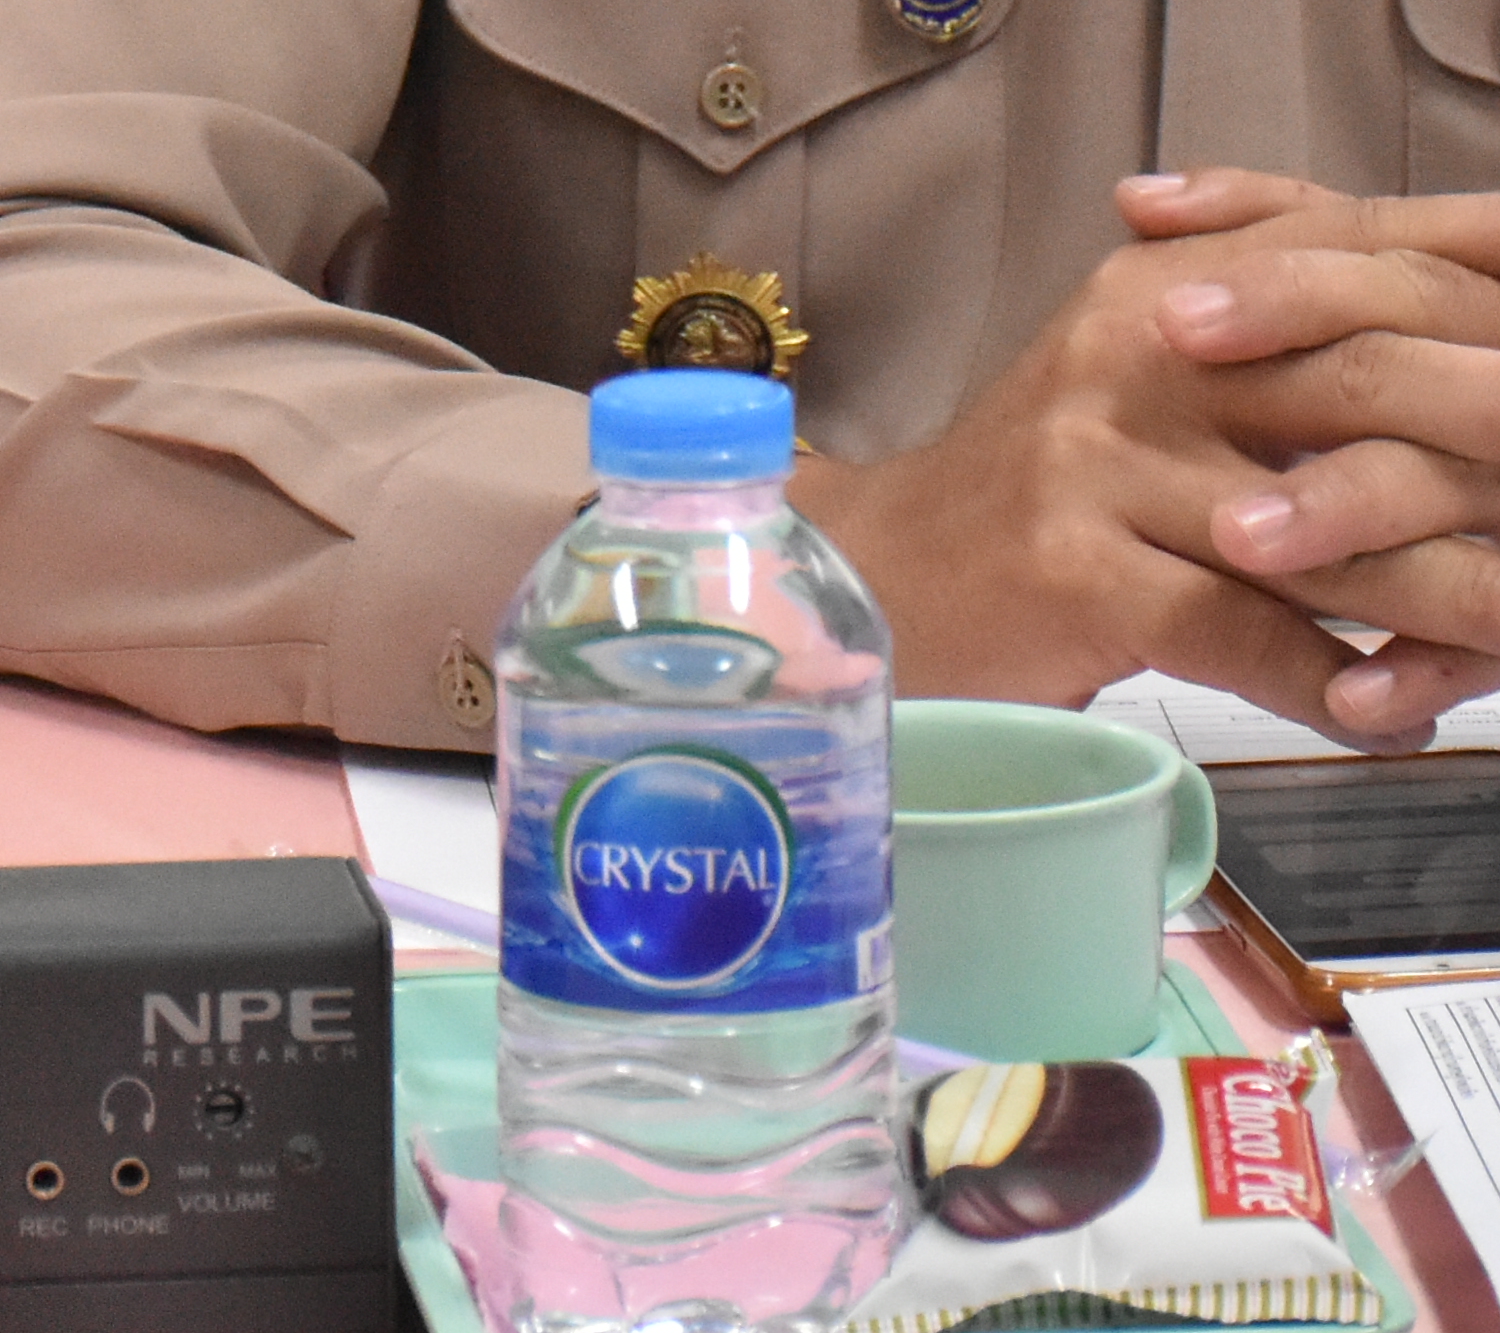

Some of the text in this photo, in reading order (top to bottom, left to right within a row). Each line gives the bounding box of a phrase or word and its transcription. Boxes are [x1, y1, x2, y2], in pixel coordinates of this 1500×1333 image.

[573, 842, 777, 894] CRYSTAL
[142, 987, 356, 1046] NPE
[142, 1046, 359, 1067] RESEARCH
[1223, 1072, 1299, 1159] Choco
[178, 1191, 277, 1214] VOLUME
[1235, 1163, 1308, 1211] Pie
[18, 1214, 171, 1237] REC PHONE
